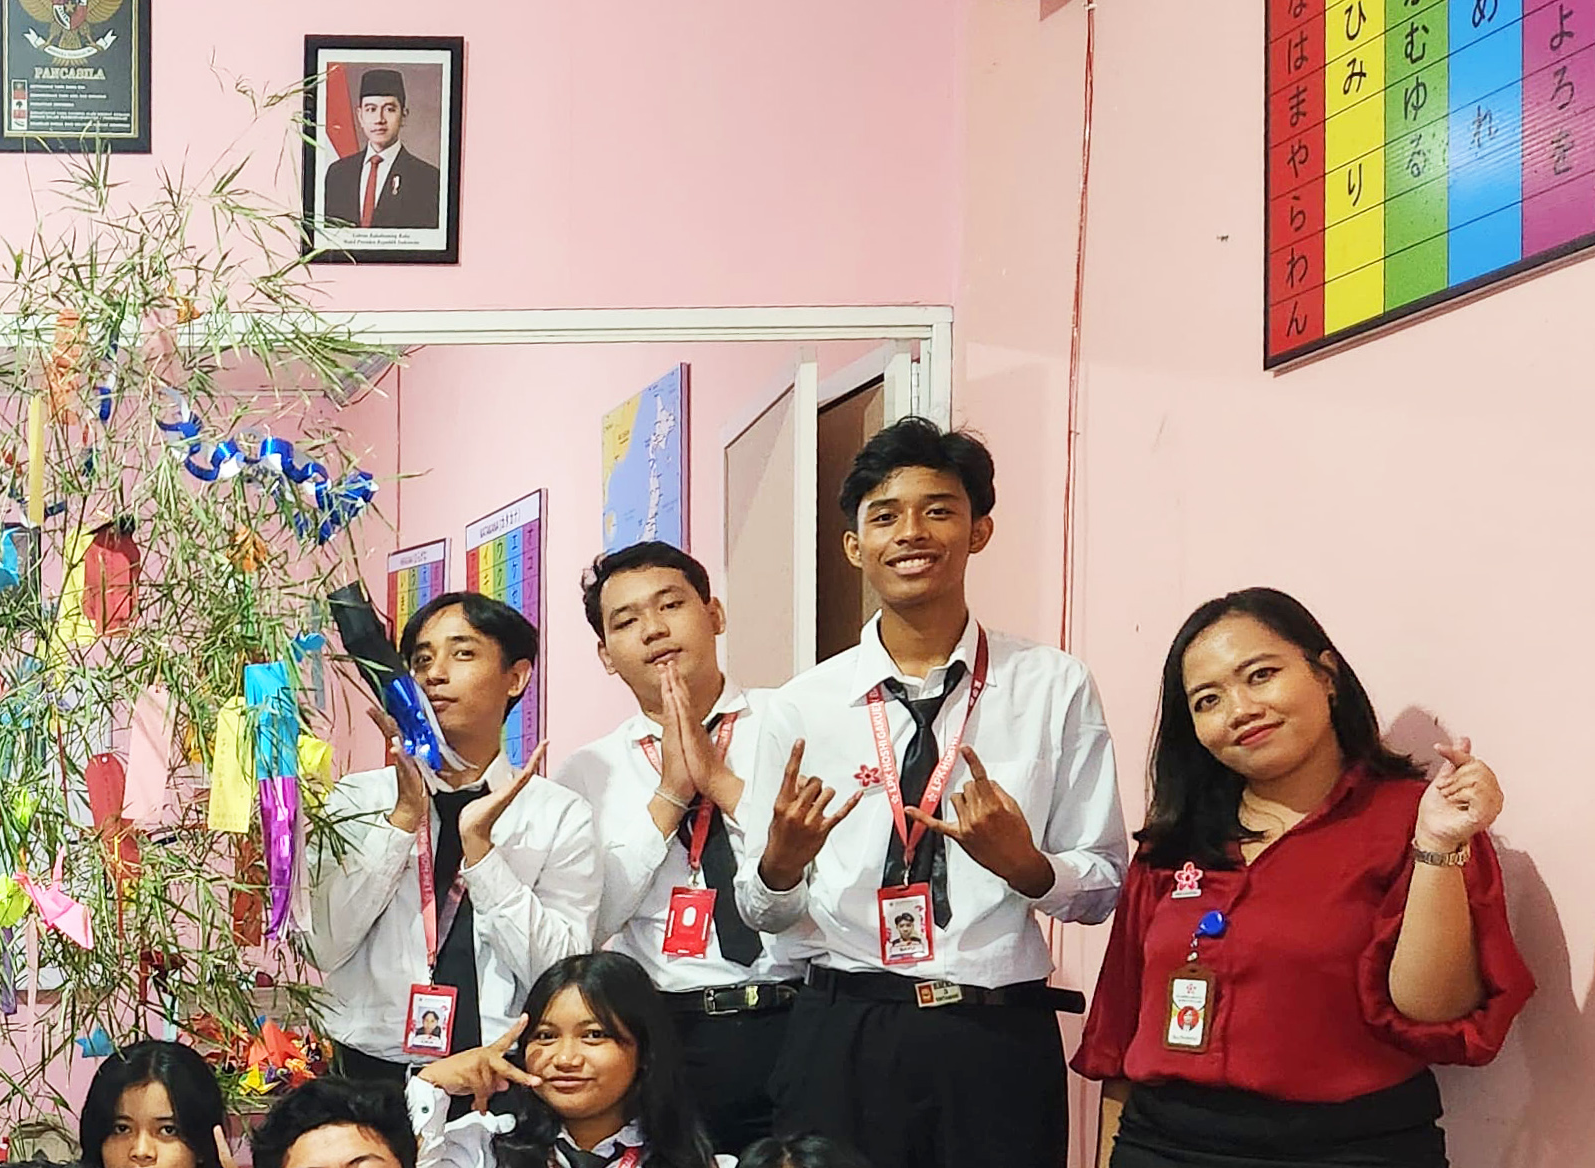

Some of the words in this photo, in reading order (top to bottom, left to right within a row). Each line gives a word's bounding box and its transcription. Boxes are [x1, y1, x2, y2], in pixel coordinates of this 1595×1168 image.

[1288, 30, 1309, 74] は
[1345, 3, 1367, 40] ひ
[33, 67, 106, 80] PANCASILA
[1287, 142, 1309, 178] や
[1404, 75, 1428, 121] ゆ
[1550, 4, 1574, 51] よ
[1289, 87, 1308, 127] ま
[1343, 58, 1367, 95] み
[1405, 22, 1430, 64] む
[1289, 196, 1307, 232] ら
[1348, 163, 1363, 207] り
[1549, 66, 1575, 111] ろ
[1286, 248, 1309, 289] わ
[1286, 300, 1307, 337] ん
[879, 740, 893, 772] HOSHI
[886, 772, 897, 793] LPK
[931, 765, 949, 791] LPK
